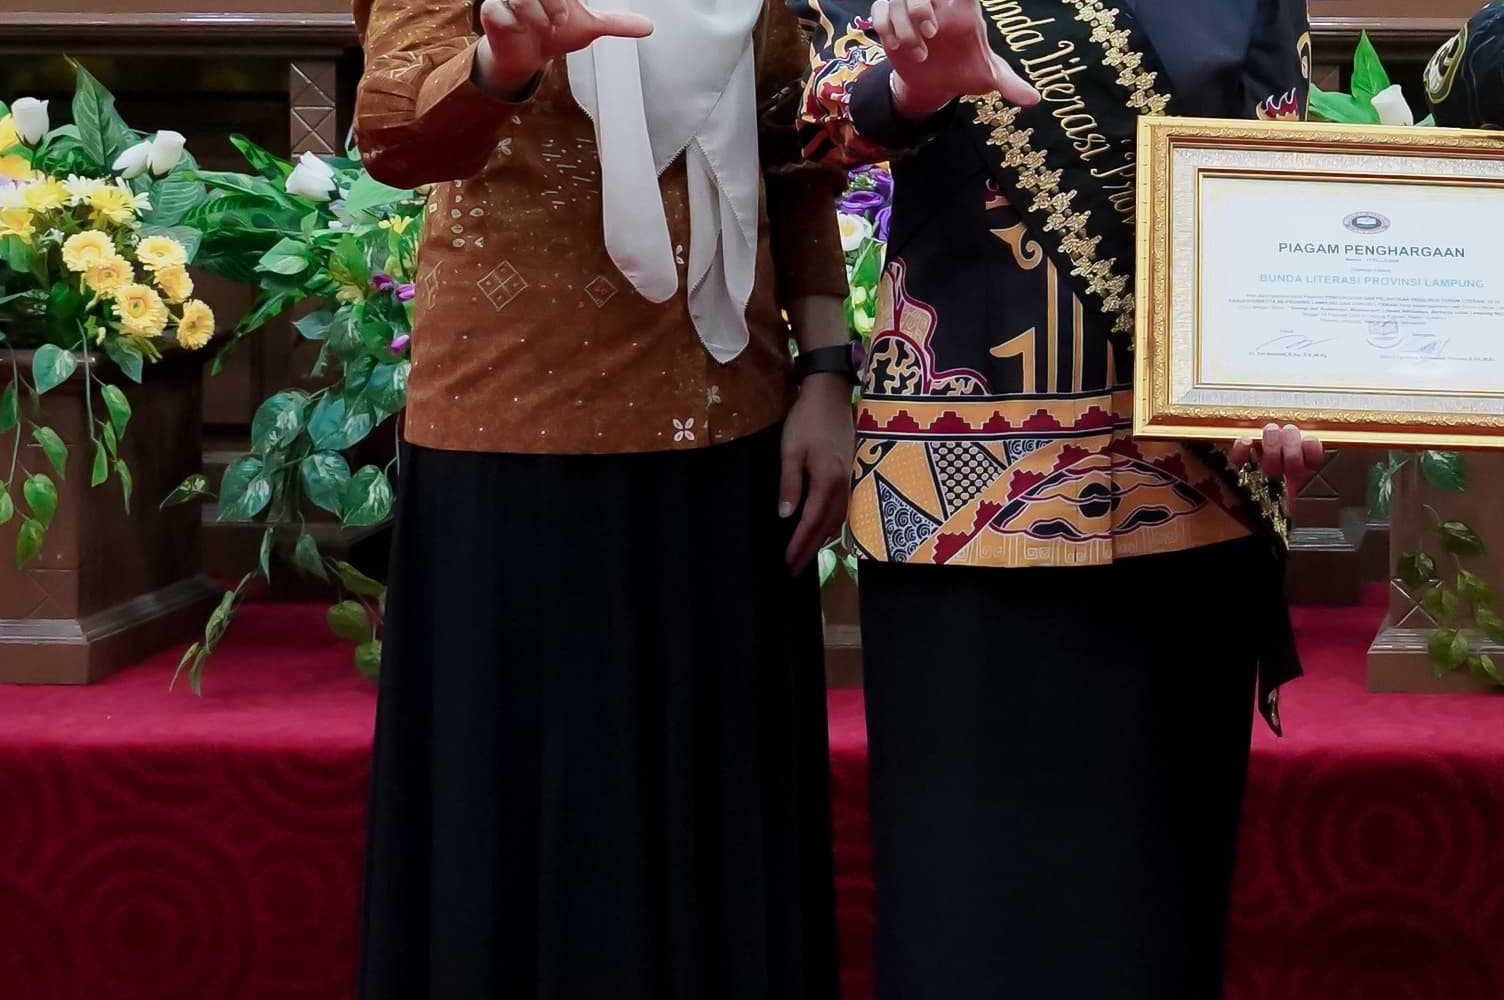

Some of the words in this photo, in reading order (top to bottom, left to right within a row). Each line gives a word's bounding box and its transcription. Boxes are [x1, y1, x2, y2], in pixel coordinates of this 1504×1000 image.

[1020, 40, 1111, 162] Literasi
[1278, 242, 1340, 255] PIAGAM
[1344, 244, 1466, 258] PENGHARGAAN
[1259, 273, 1303, 283] BUNDA
[1305, 274, 1361, 285] LITERASI
[1364, 276, 1421, 287] PROVINSI
[1424, 278, 1485, 289] LAMPUNG
